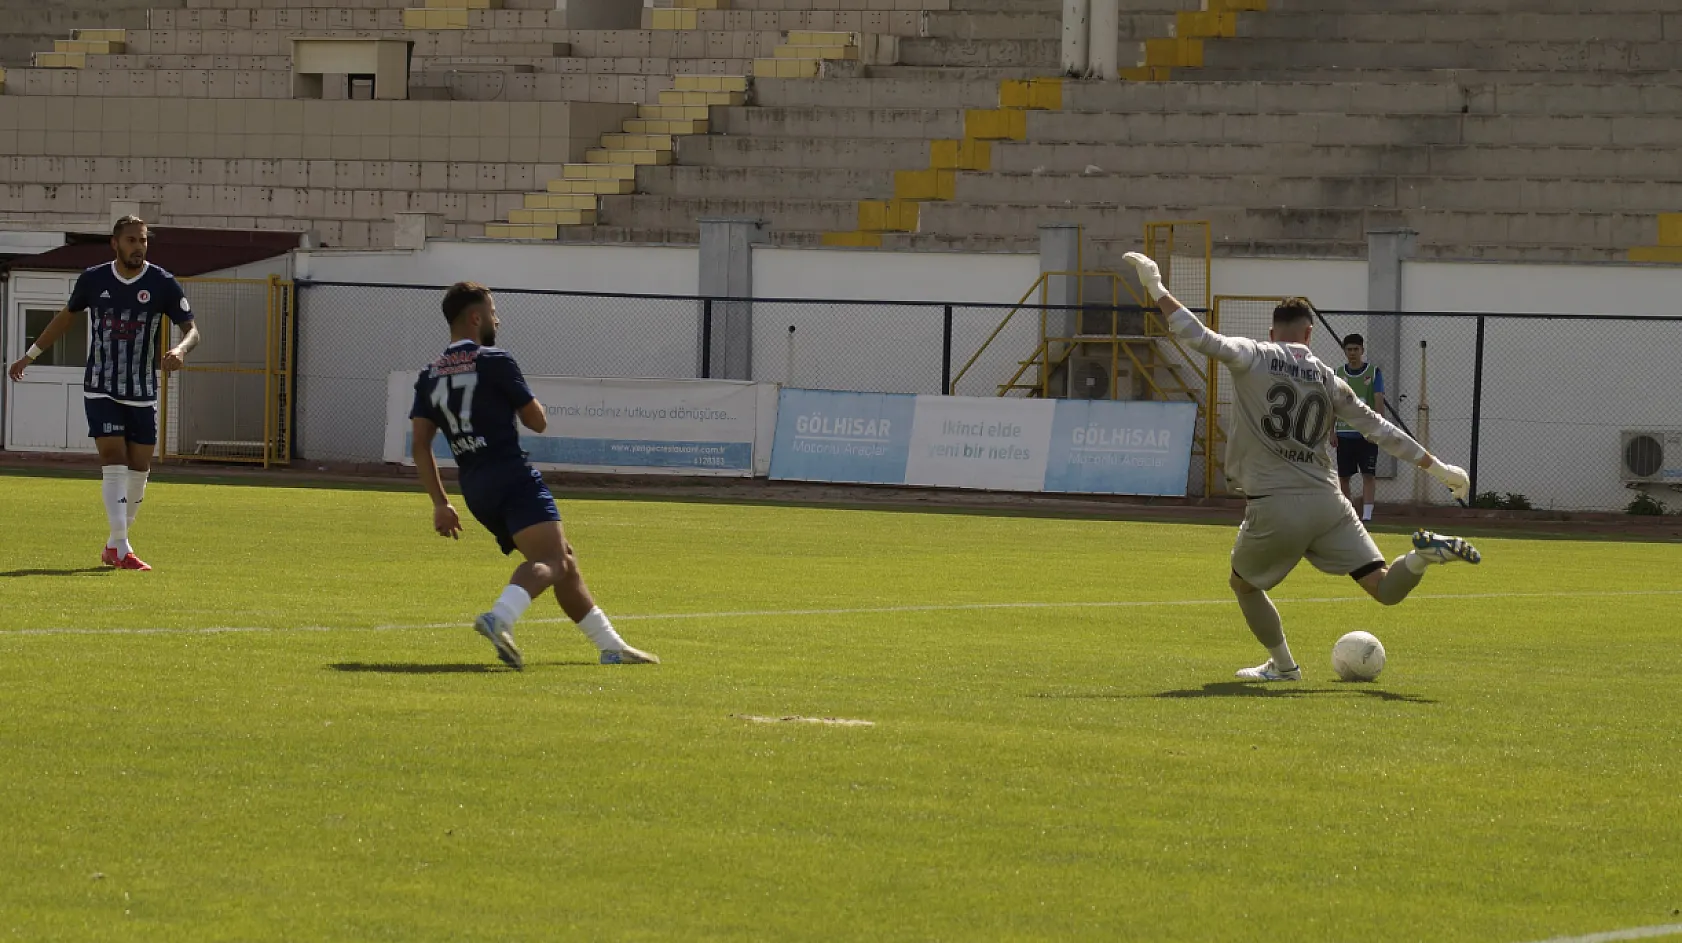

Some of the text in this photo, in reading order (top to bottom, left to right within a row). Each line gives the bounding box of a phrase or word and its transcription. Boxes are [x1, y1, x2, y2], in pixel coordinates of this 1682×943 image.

[430, 373, 479, 434] 17
[624, 407, 666, 421] tutkuya
[670, 406, 737, 422] dönüşürse...
[1261, 382, 1331, 449] 30
[988, 421, 1022, 437] elde
[792, 440, 888, 458] Motorlu Araçlar
[927, 443, 1031, 460] yeni bir nefes
[1276, 447, 1314, 464] URAK
[1068, 452, 1117, 466] Motorlu
